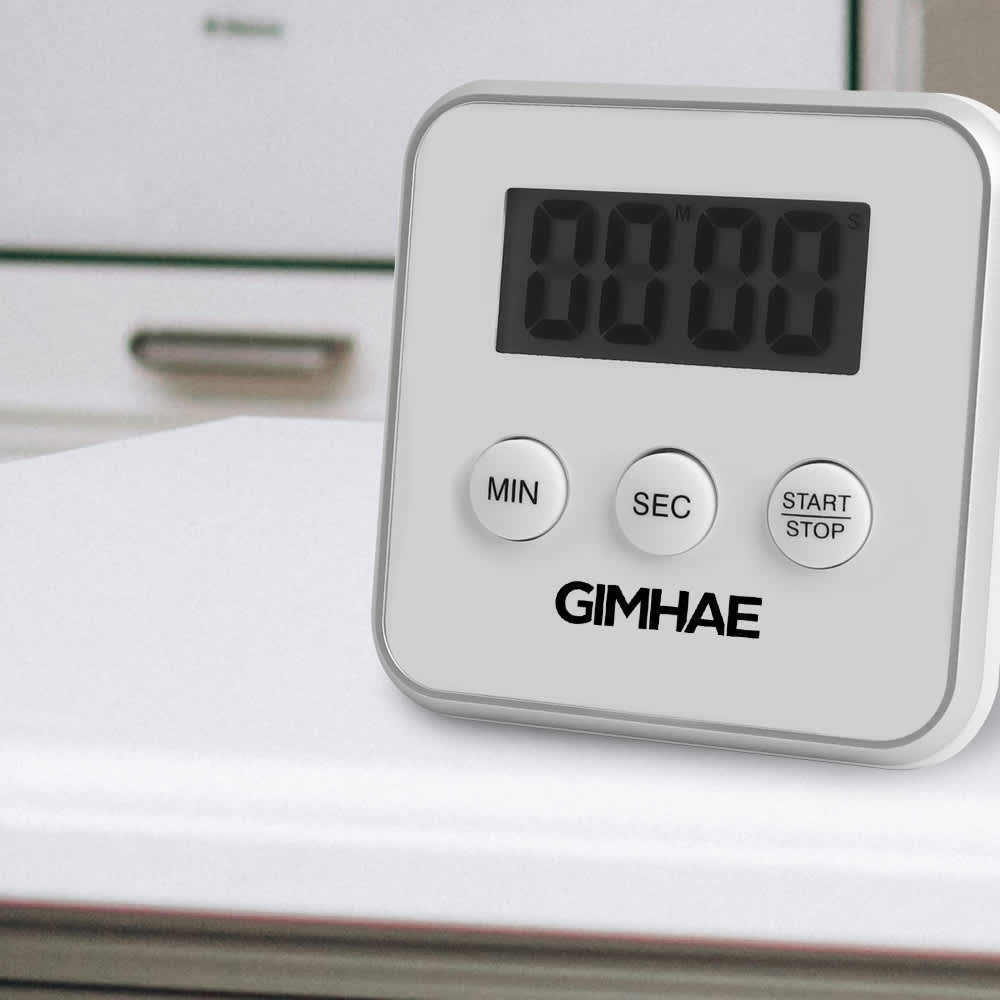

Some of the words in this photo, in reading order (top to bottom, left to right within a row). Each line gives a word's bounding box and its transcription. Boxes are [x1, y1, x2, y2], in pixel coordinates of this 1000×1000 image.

[674, 204, 691, 223] M
[846, 211, 862, 231] S
[487, 476, 539, 505] MIN
[782, 491, 852, 512] START
[632, 491, 691, 520] SEC
[786, 520, 846, 540] STOP
[554, 580, 763, 640] GIMHAE
